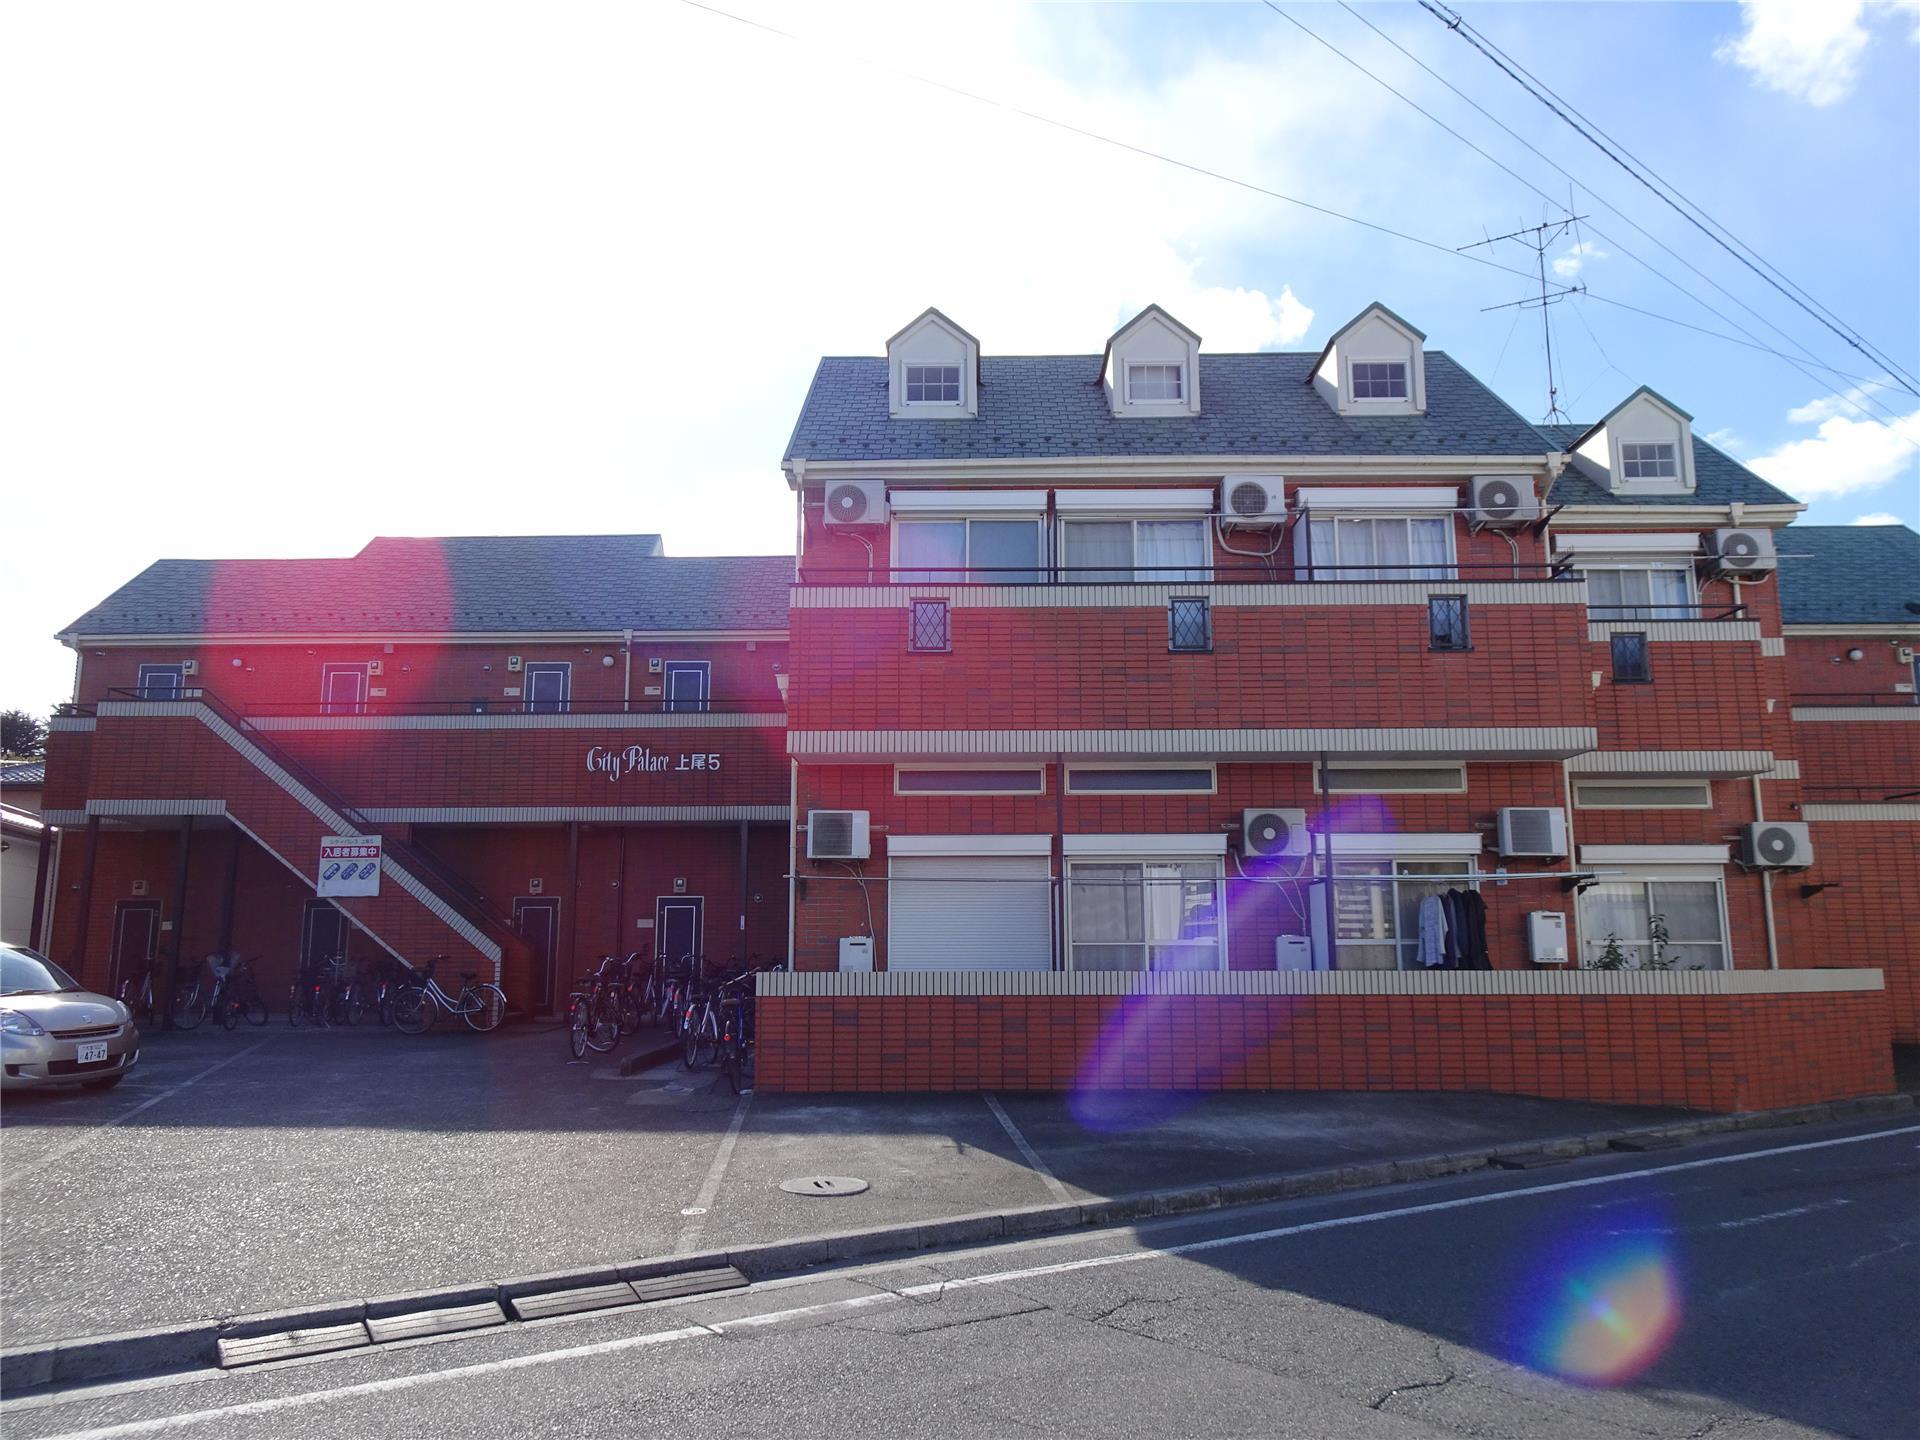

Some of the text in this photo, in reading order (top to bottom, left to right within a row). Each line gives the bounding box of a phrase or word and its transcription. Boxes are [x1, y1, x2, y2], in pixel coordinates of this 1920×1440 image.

[586, 745, 720, 782] City Palace 上尾5
